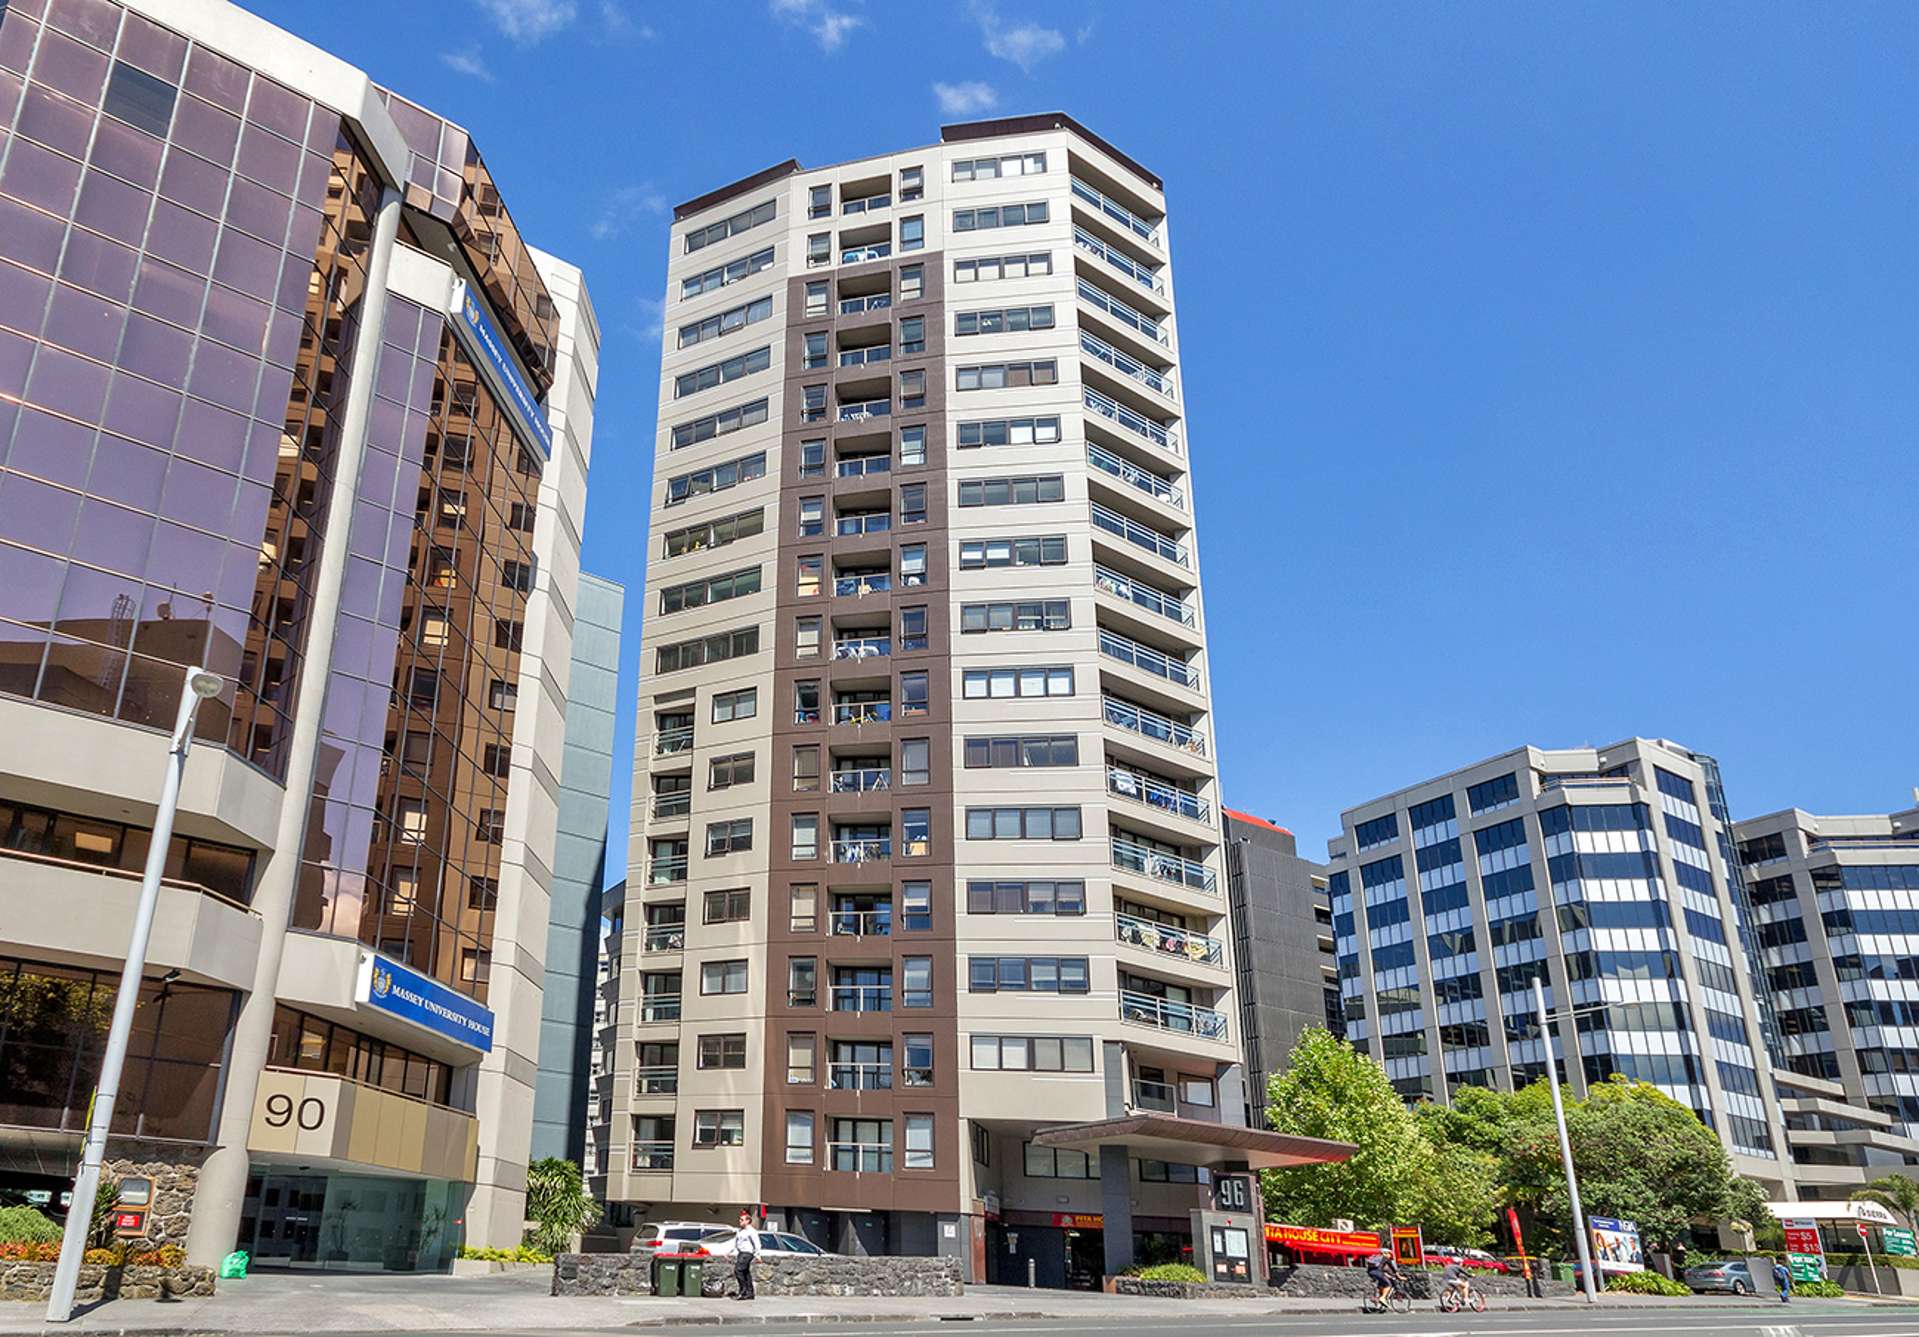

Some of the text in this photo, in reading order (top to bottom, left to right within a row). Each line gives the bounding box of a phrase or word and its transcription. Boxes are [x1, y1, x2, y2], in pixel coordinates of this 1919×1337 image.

[392, 984, 491, 1037] MASSEY UNIVERSITY HOUSE
[265, 1093, 325, 1131] 90
[1221, 1180, 1244, 1206] 96
[1283, 1228, 1319, 1242] HOUSE
[1320, 1231, 1341, 1245] CITY
